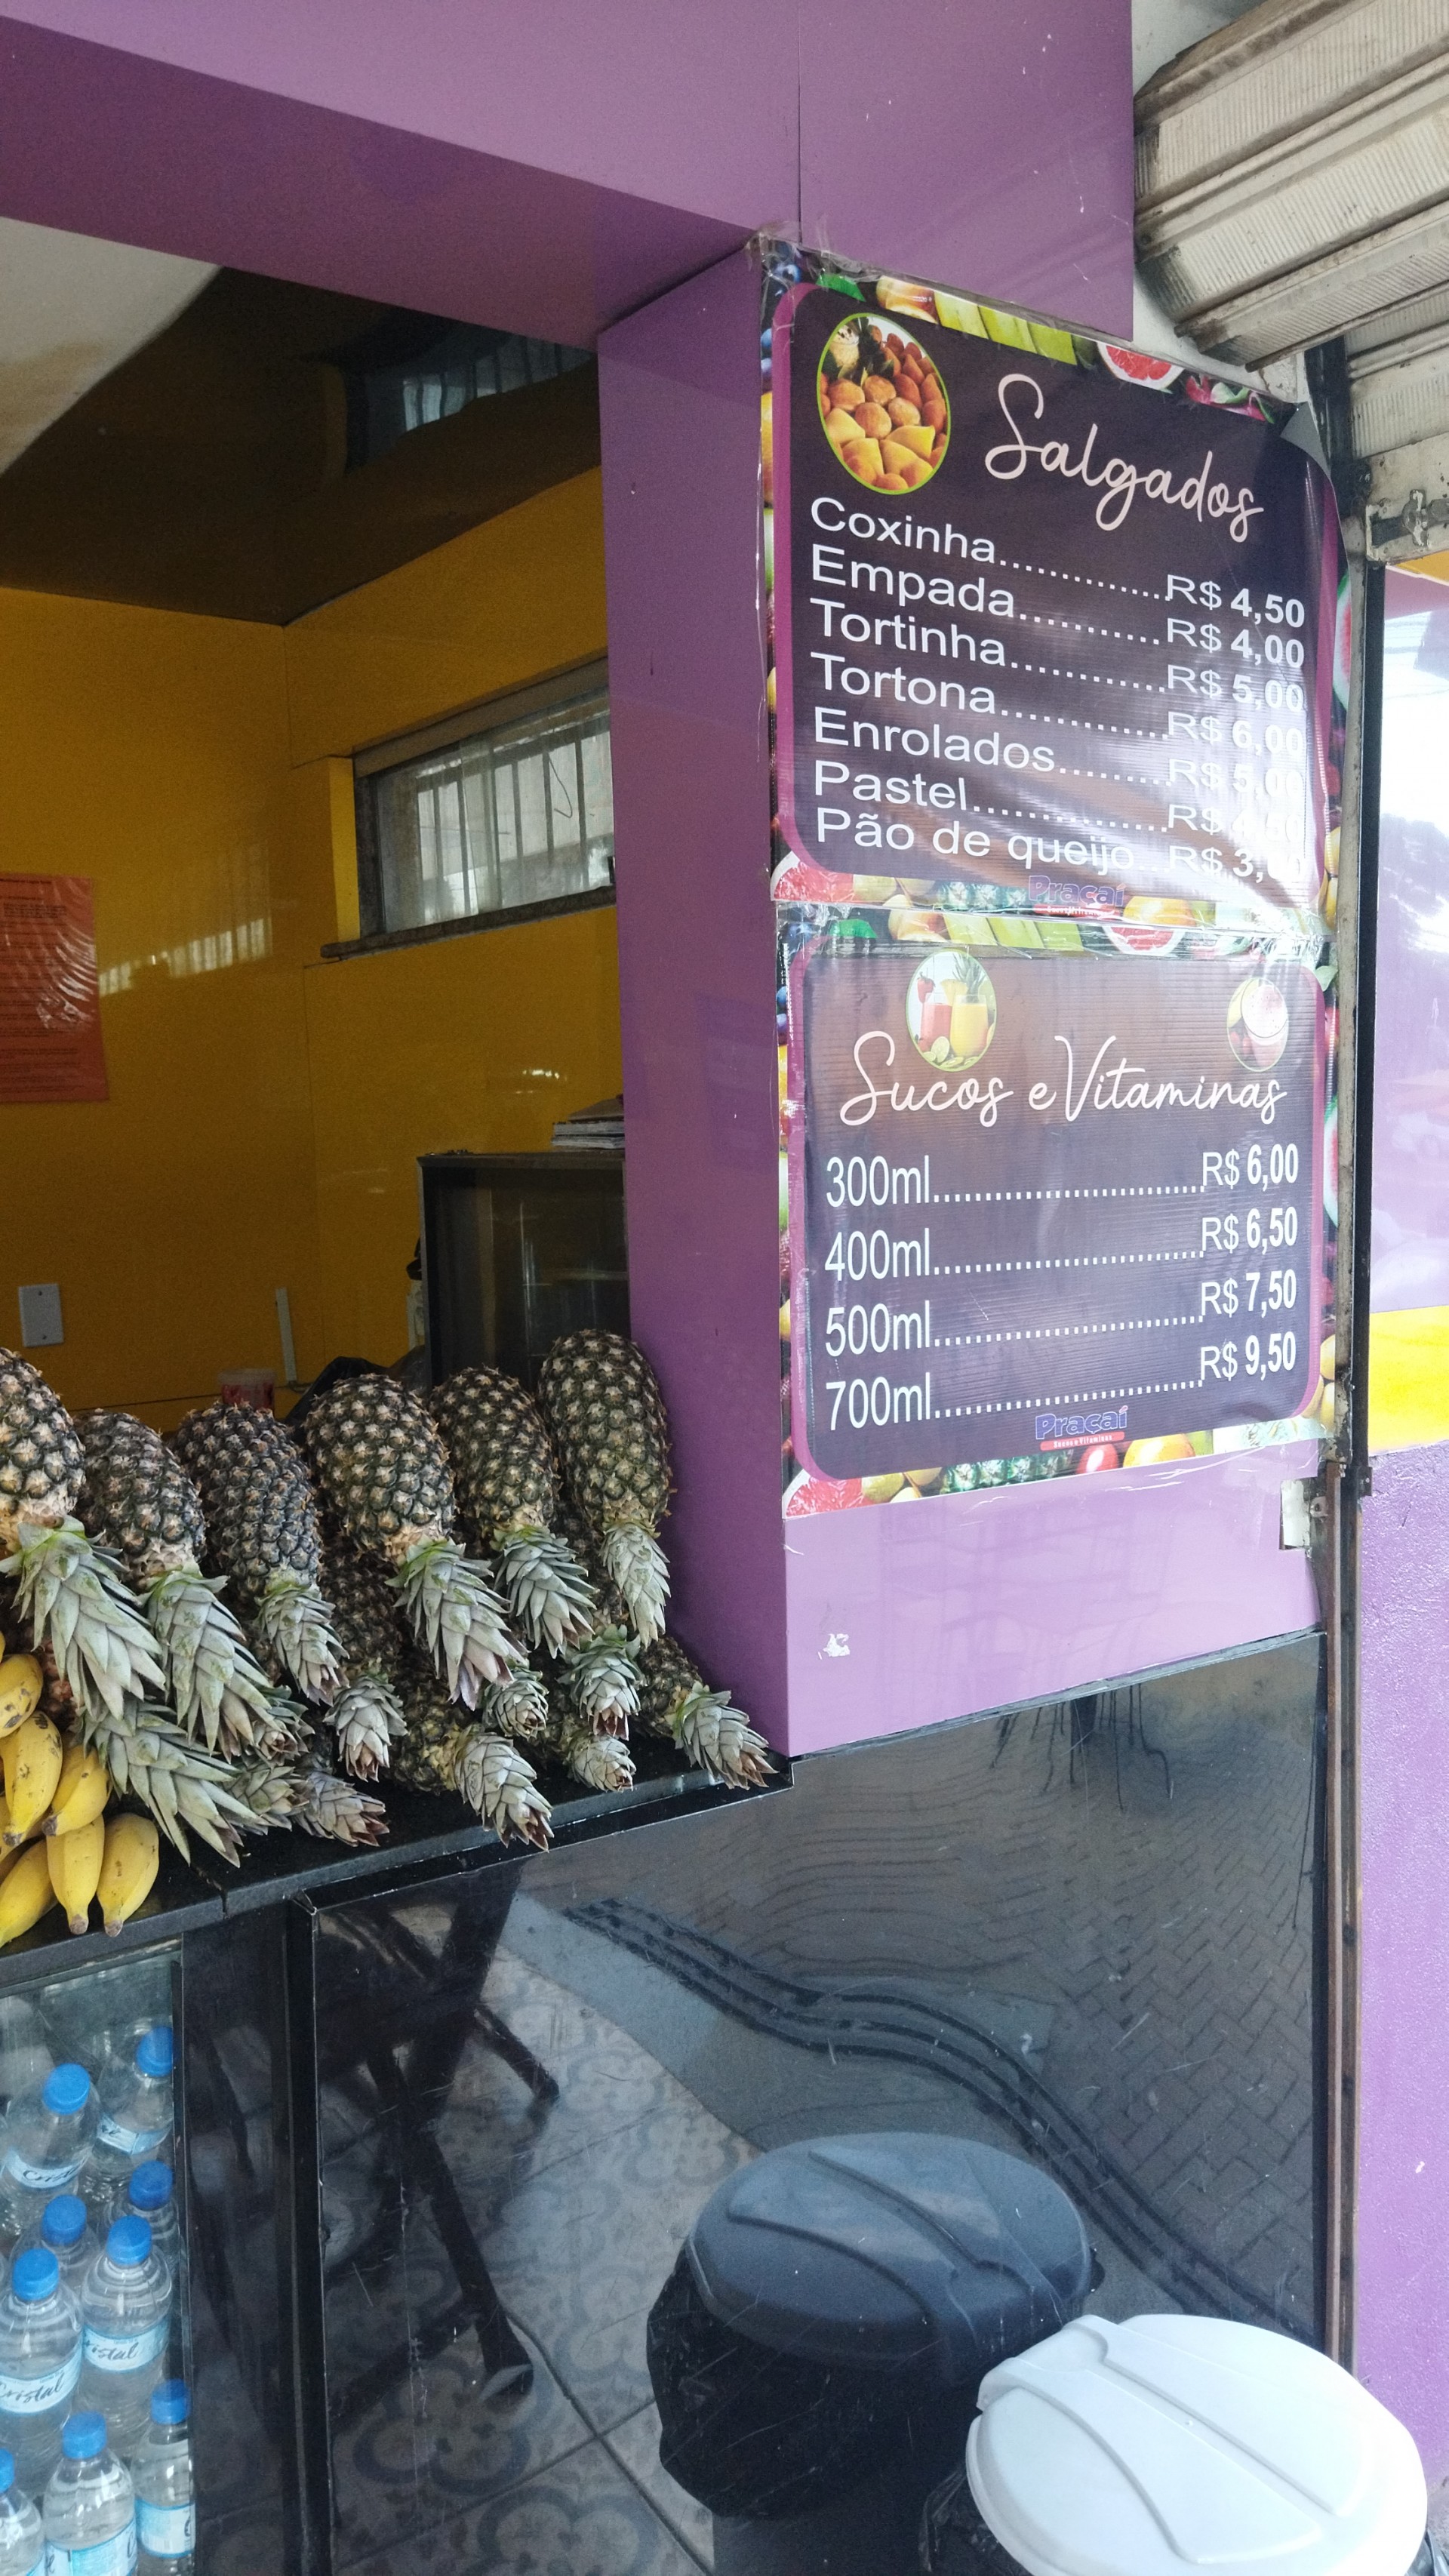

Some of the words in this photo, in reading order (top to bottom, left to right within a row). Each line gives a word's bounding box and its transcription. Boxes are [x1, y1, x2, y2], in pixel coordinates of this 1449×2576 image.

[984, 374, 1265, 543] Salgados
[811, 497, 995, 564] Coxinha
[1167, 574, 1223, 610] R$
[1230, 587, 1305, 628] 4,50
[812, 543, 1014, 617] Empada
[1167, 617, 1223, 654] R$
[1230, 629, 1304, 668] 4,00
[810, 597, 1006, 666] Tortinha
[1168, 664, 1223, 699] R$
[1232, 674, 1304, 712] 5,00
[811, 651, 996, 714] Tortona
[1168, 711, 1223, 745] R$
[1232, 720, 1304, 756] 6,00
[815, 706, 1055, 772] Enrolados
[1169, 759, 1223, 790] R$
[815, 759, 967, 811] Pastel
[1168, 804, 1223, 836] R$
[817, 807, 915, 850] Pão
[932, 820, 991, 857] de
[1008, 834, 1134, 876] queijo
[1169, 845, 1223, 873] R$
[840, 1030, 1014, 1127] Sucos
[1029, 1082, 1057, 1110] e
[1054, 1035, 1287, 1125] Vitaminas
[826, 1155, 930, 1207] 300ml
[1202, 1149, 1240, 1190] R$
[1247, 1143, 1299, 1192] 6,00
[825, 1227, 930, 1281] 400ml
[1201, 1213, 1239, 1254] R$
[1247, 1206, 1298, 1255] 6,50
[826, 1300, 930, 1357] 500ml
[1201, 1277, 1238, 1318] R$
[1245, 1269, 1297, 1318] 7,50
[826, 1371, 931, 1430] 700ml
[1200, 1340, 1238, 1381] R$
[1245, 1331, 1297, 1380] 9,50
[1035, 1405, 1129, 1440] Praçaí
[82, 2339, 139, 2361] ristal
